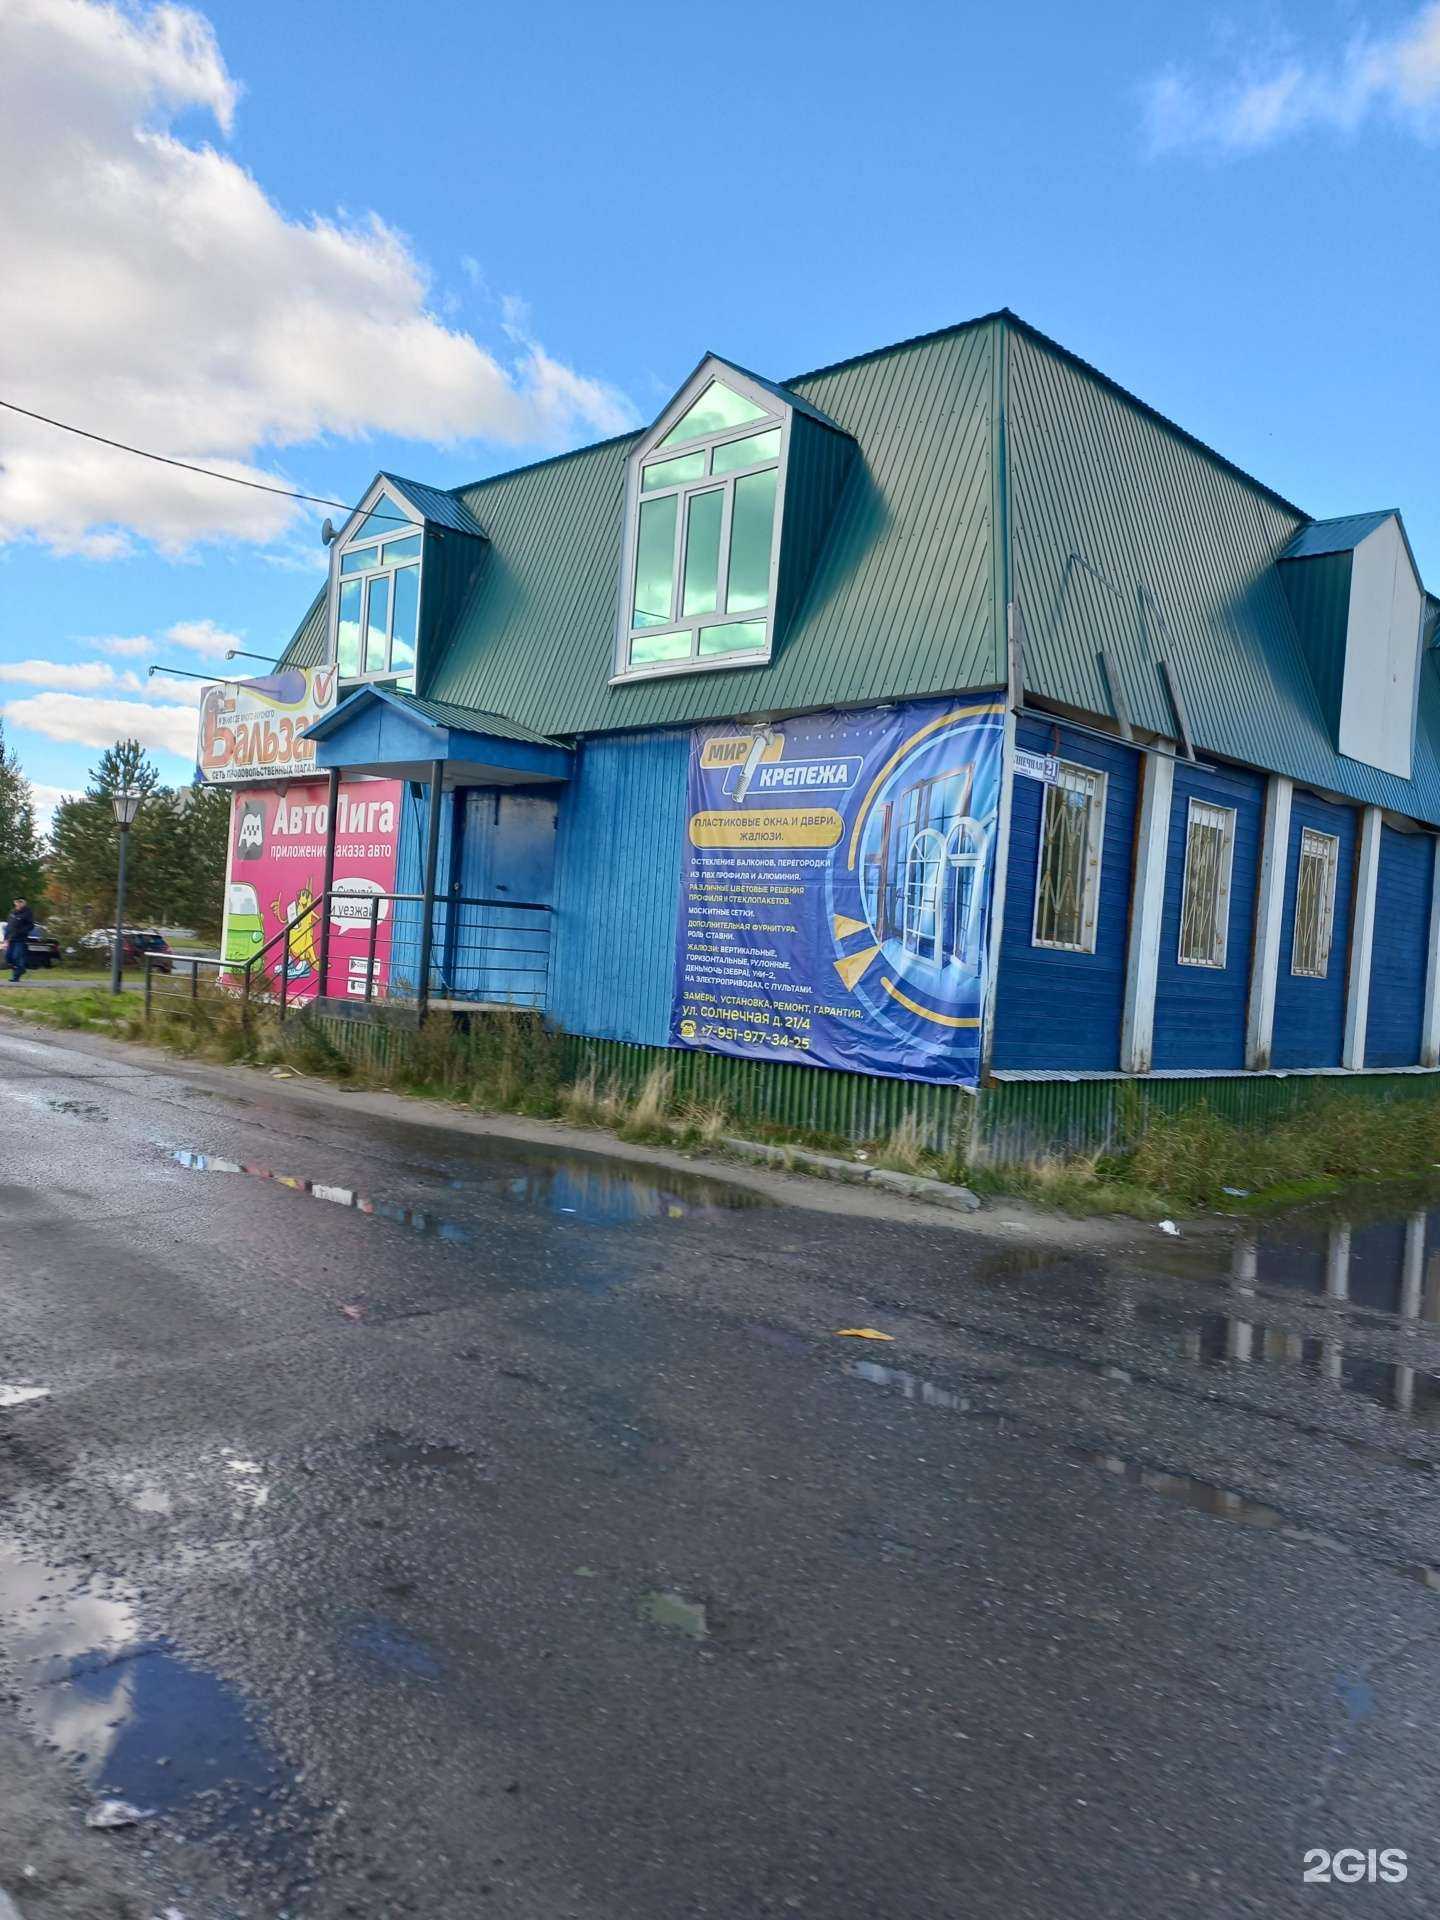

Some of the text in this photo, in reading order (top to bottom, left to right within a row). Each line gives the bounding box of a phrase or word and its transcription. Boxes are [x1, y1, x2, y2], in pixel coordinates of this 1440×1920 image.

[202, 688, 319, 770] Бальза
[708, 743, 748, 761] МИР
[760, 764, 847, 787] КРЕПЕЖА
[694, 816, 836, 828] ПЛАСТИКОВЫЕ ОКНА И ДВЕРИ.
[367, 843, 391, 858] авто
[691, 858, 735, 867] ОСТЕКЛЕНИЕ
[778, 859, 831, 869] ПЕРЕГОРОДКИ
[716, 872, 750, 880] ПРОФИЛЯ
[689, 884, 805, 895] РАЗЛИЧНЫЕ ЦВЕТОВЫЕ РЕШЕНИЯ
[688, 907, 730, 916] МОСКИТНЫЕ
[688, 920, 750, 930] ДОПОЛНИТЕЛЬНАЯ
[687, 930, 704, 938] РОЛЬ
[764, 982, 770, 990] С
[785, 1017, 811, 1030] 21/4
[701, 1024, 811, 1050] +7-951-977-34-25
